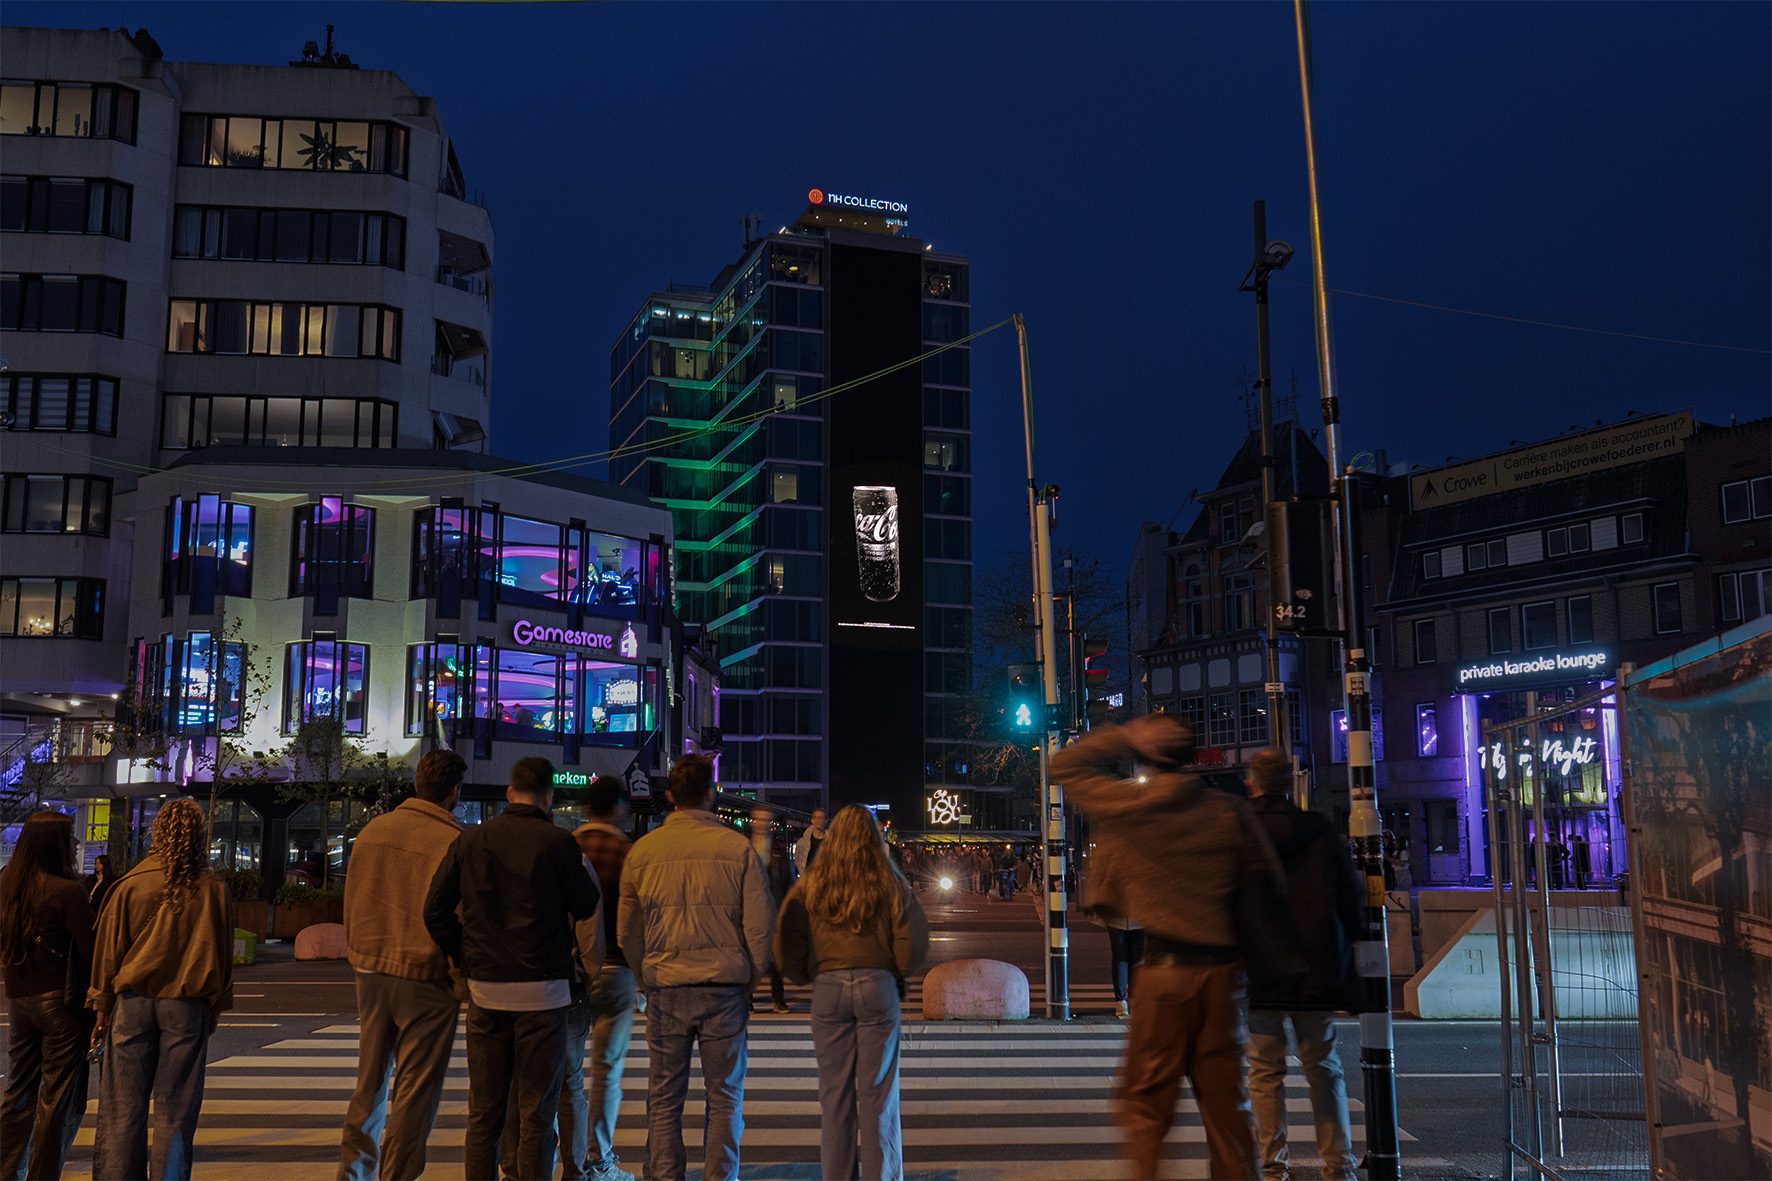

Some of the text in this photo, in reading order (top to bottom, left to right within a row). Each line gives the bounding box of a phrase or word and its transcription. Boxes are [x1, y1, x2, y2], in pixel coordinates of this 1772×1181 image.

[844, 196, 908, 212] COLLECTION
[1551, 443, 1588, 459] maken
[1592, 437, 1608, 450] als
[1612, 417, 1685, 444] accountant?
[1443, 472, 1487, 493] Crowe
[1276, 604, 1306, 619] 34.2
[1460, 652, 1606, 683] private karaoke lounge
[1542, 736, 1597, 776] Night
[553, 771, 587, 785] neken
